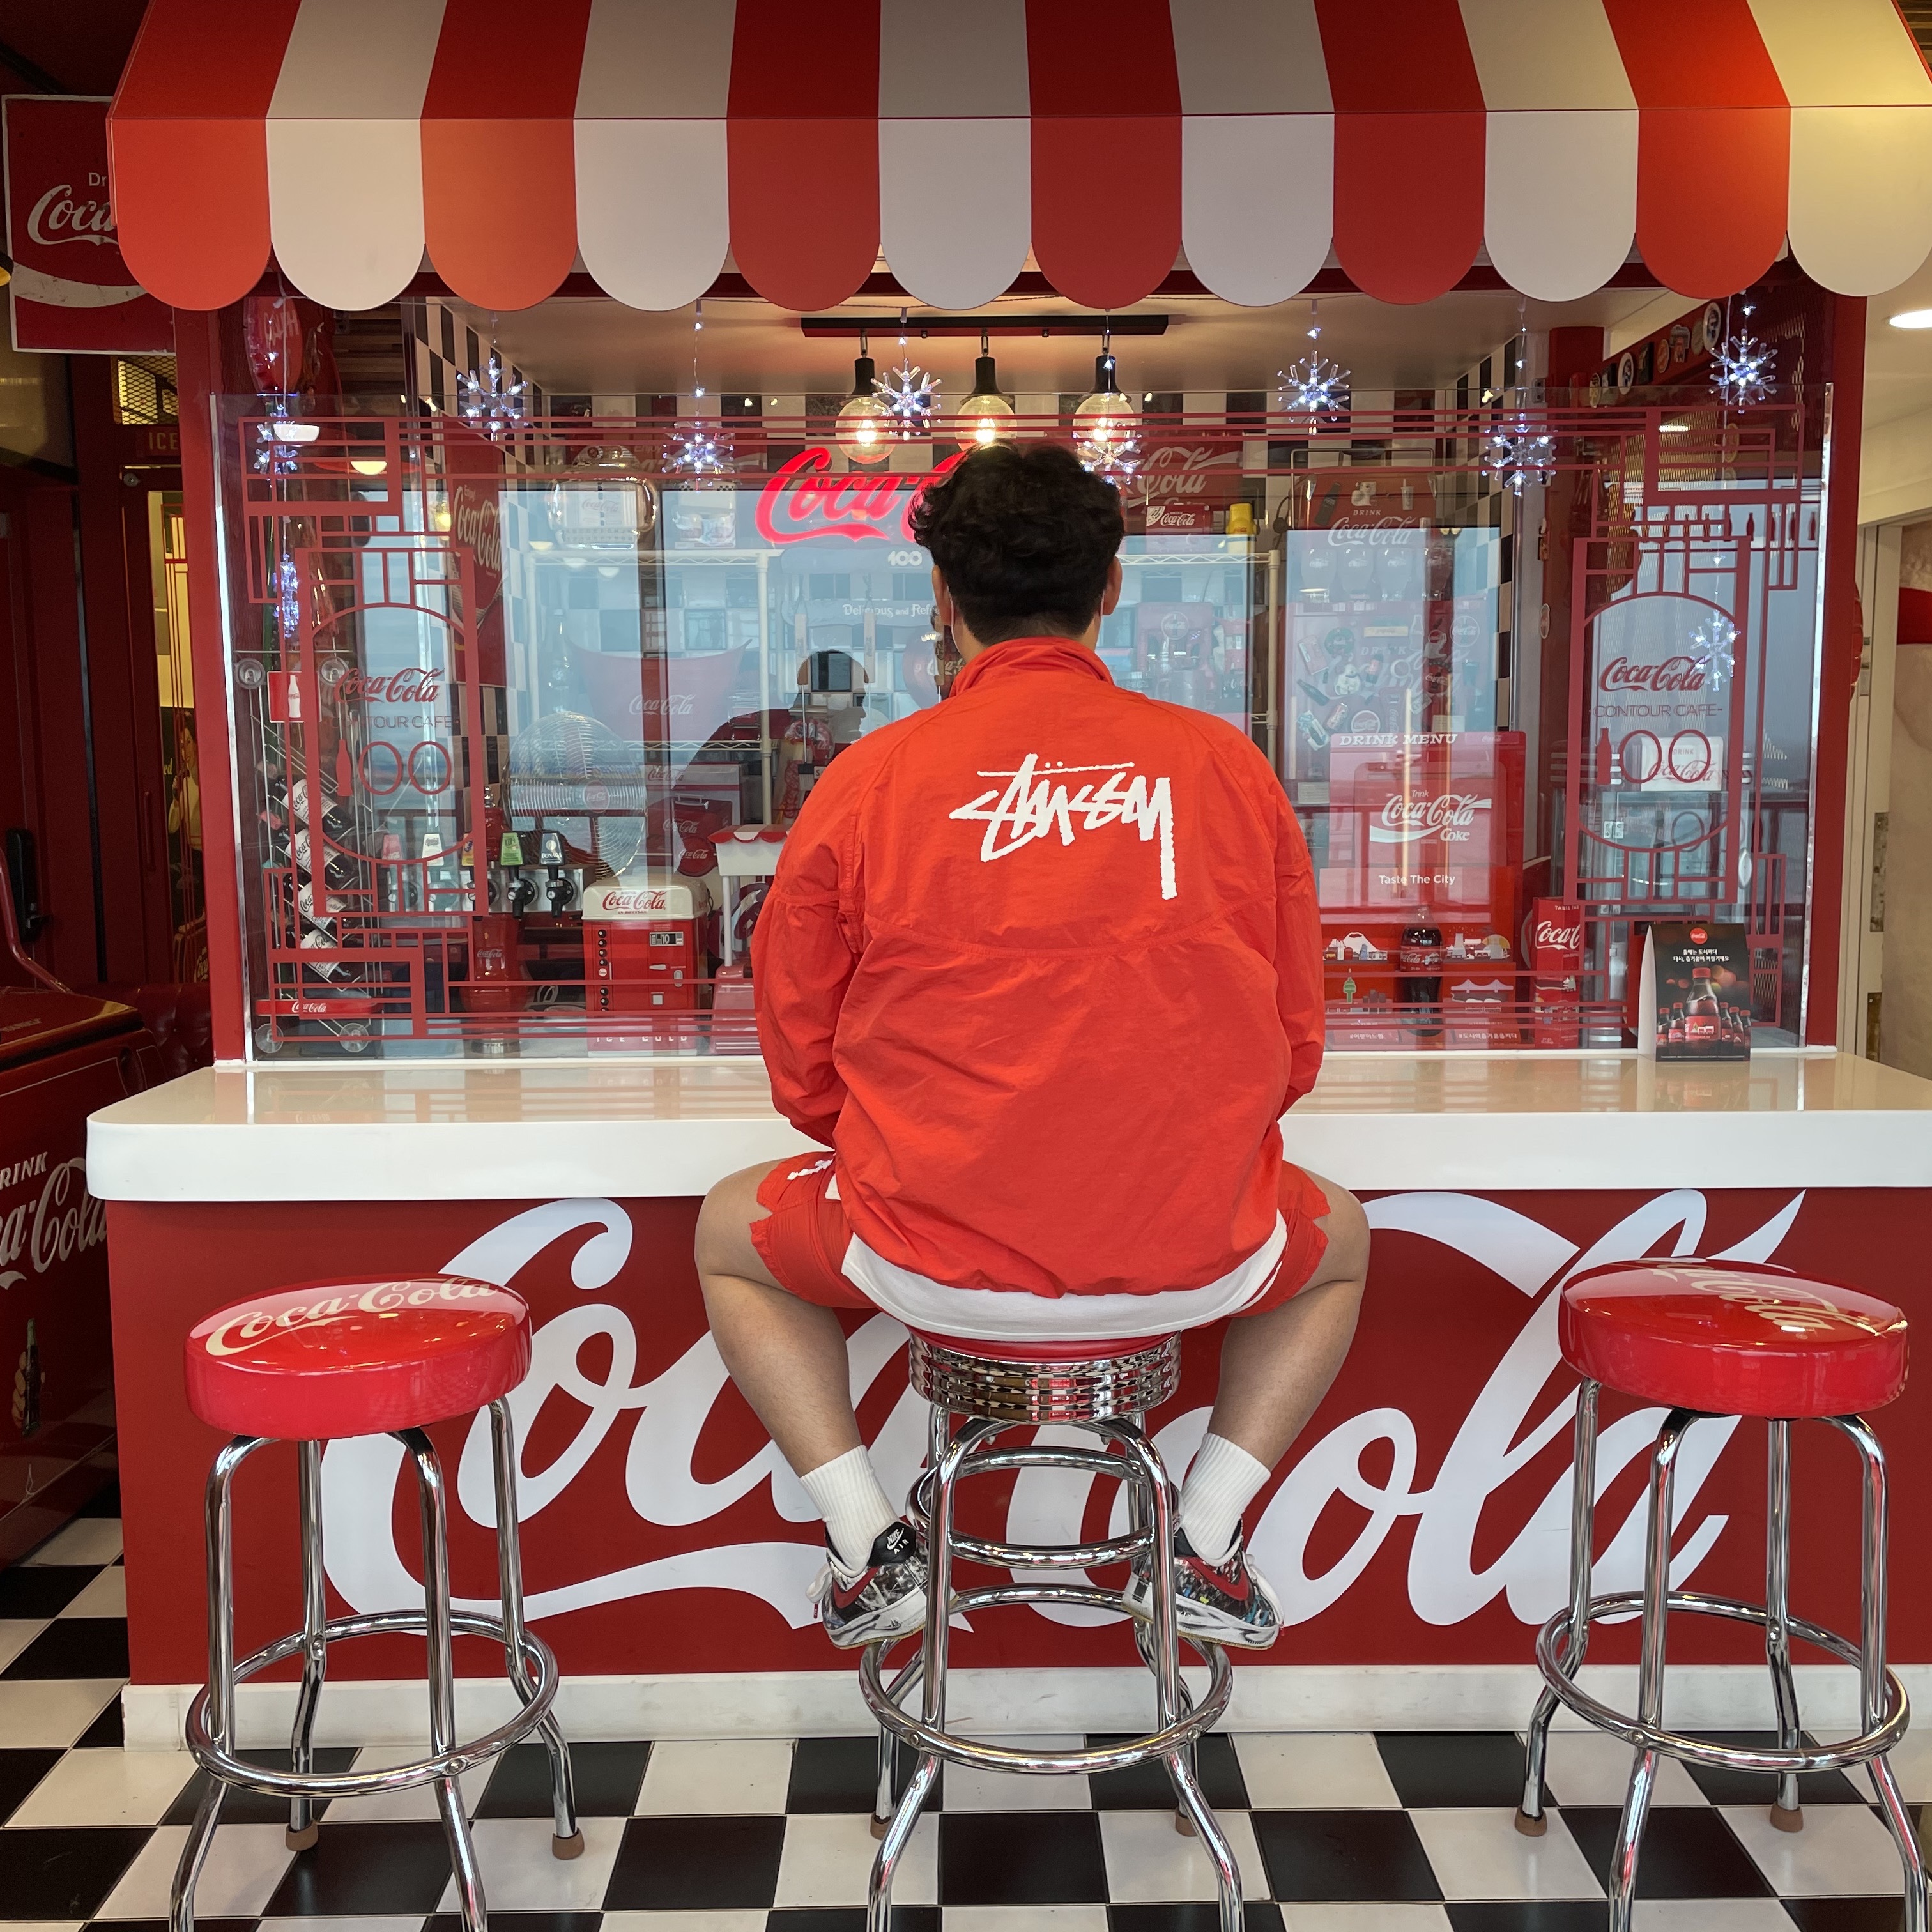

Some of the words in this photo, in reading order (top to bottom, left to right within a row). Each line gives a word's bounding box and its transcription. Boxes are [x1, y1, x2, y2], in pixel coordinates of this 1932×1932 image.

[1160, 513, 1195, 526] Coca-Cola
[1328, 516, 1416, 546] Coca-Cola
[888, 551, 923, 567] 100
[1600, 657, 1712, 692] Coca-Cola
[334, 668, 445, 703] Coca-Cola
[629, 694, 696, 715] Coca-Cola
[1593, 705, 1671, 717] CONTOUR
[1339, 733, 1398, 746] DRINK
[1403, 733, 1458, 745] MENU
[1381, 794, 1478, 827] Coca-Cola
[1440, 828, 1471, 841] Coke
[1378, 875, 1406, 884] Taste
[1410, 875, 1430, 884] The
[1434, 874, 1455, 885] City
[602, 890, 667, 910] Coca-Cola
[1536, 920, 1580, 949] Coca-C
[291, 1001, 327, 1013] Cca-Cola
[0, 1151, 48, 1190] RINK
[205, 1276, 500, 1356] Coca-Cola
[323, 1189, 1807, 1636] CocaCola
[886, 1528, 900, 1544] NIKE
[893, 1538, 910, 1555] AIR
